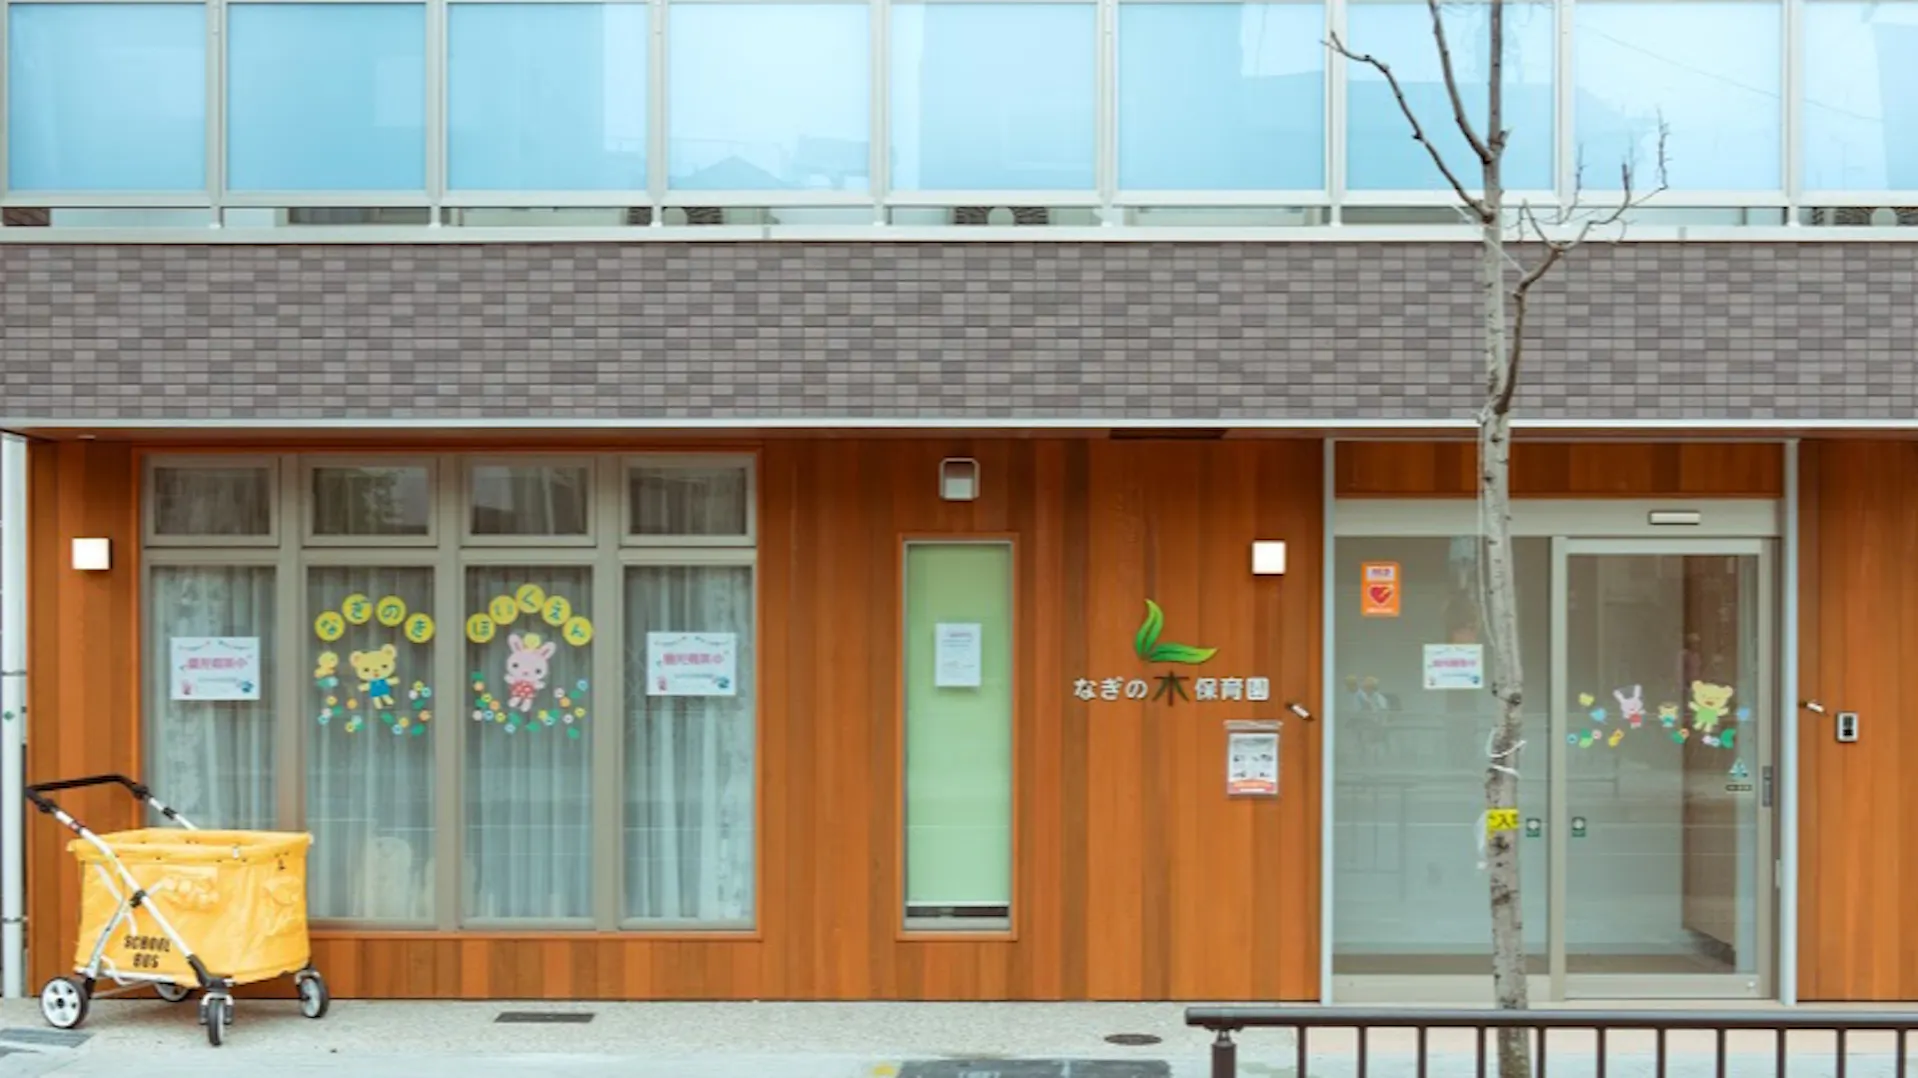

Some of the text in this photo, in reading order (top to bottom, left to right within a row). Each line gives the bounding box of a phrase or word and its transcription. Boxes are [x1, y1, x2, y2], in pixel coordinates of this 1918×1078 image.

[318, 587, 587, 640] なぎのき ほいくえん
[1073, 671, 1270, 707] なぎの木保育園
[124, 935, 170, 952] SCHOOL
[133, 953, 159, 968] BUS
